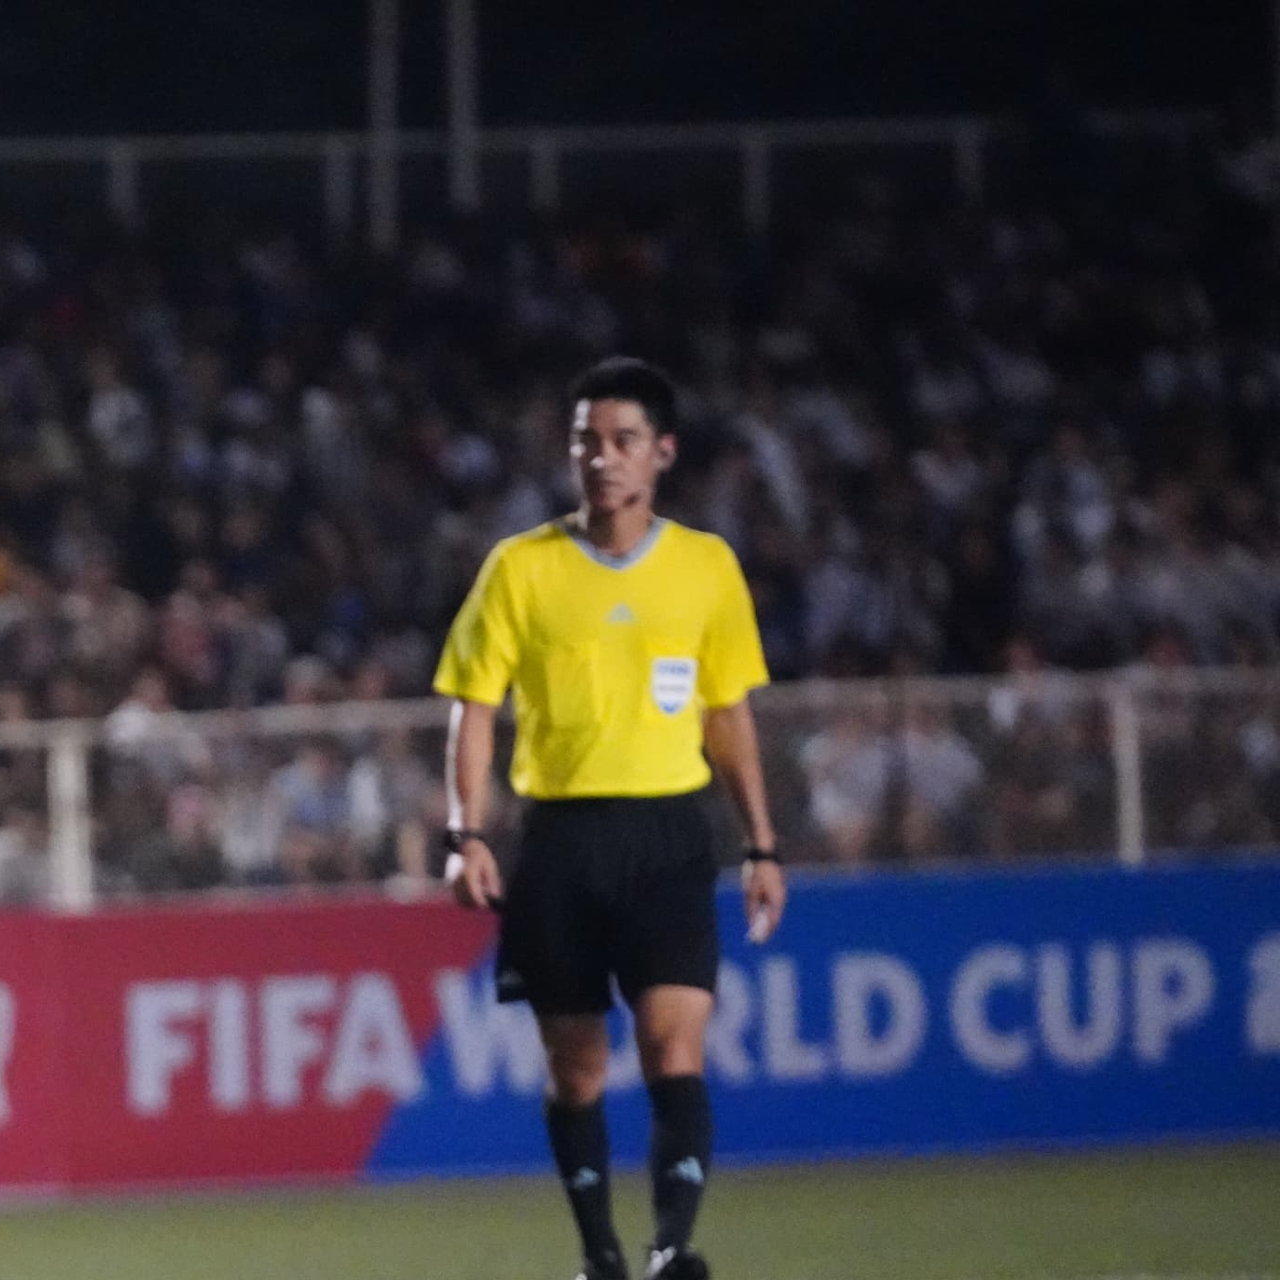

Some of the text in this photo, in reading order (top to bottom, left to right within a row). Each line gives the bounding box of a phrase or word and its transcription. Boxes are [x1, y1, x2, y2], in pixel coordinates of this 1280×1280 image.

[126, 972, 423, 1117] FIFA
[436, 954, 928, 1095] WRLD
[948, 936, 1215, 1074] CUP
